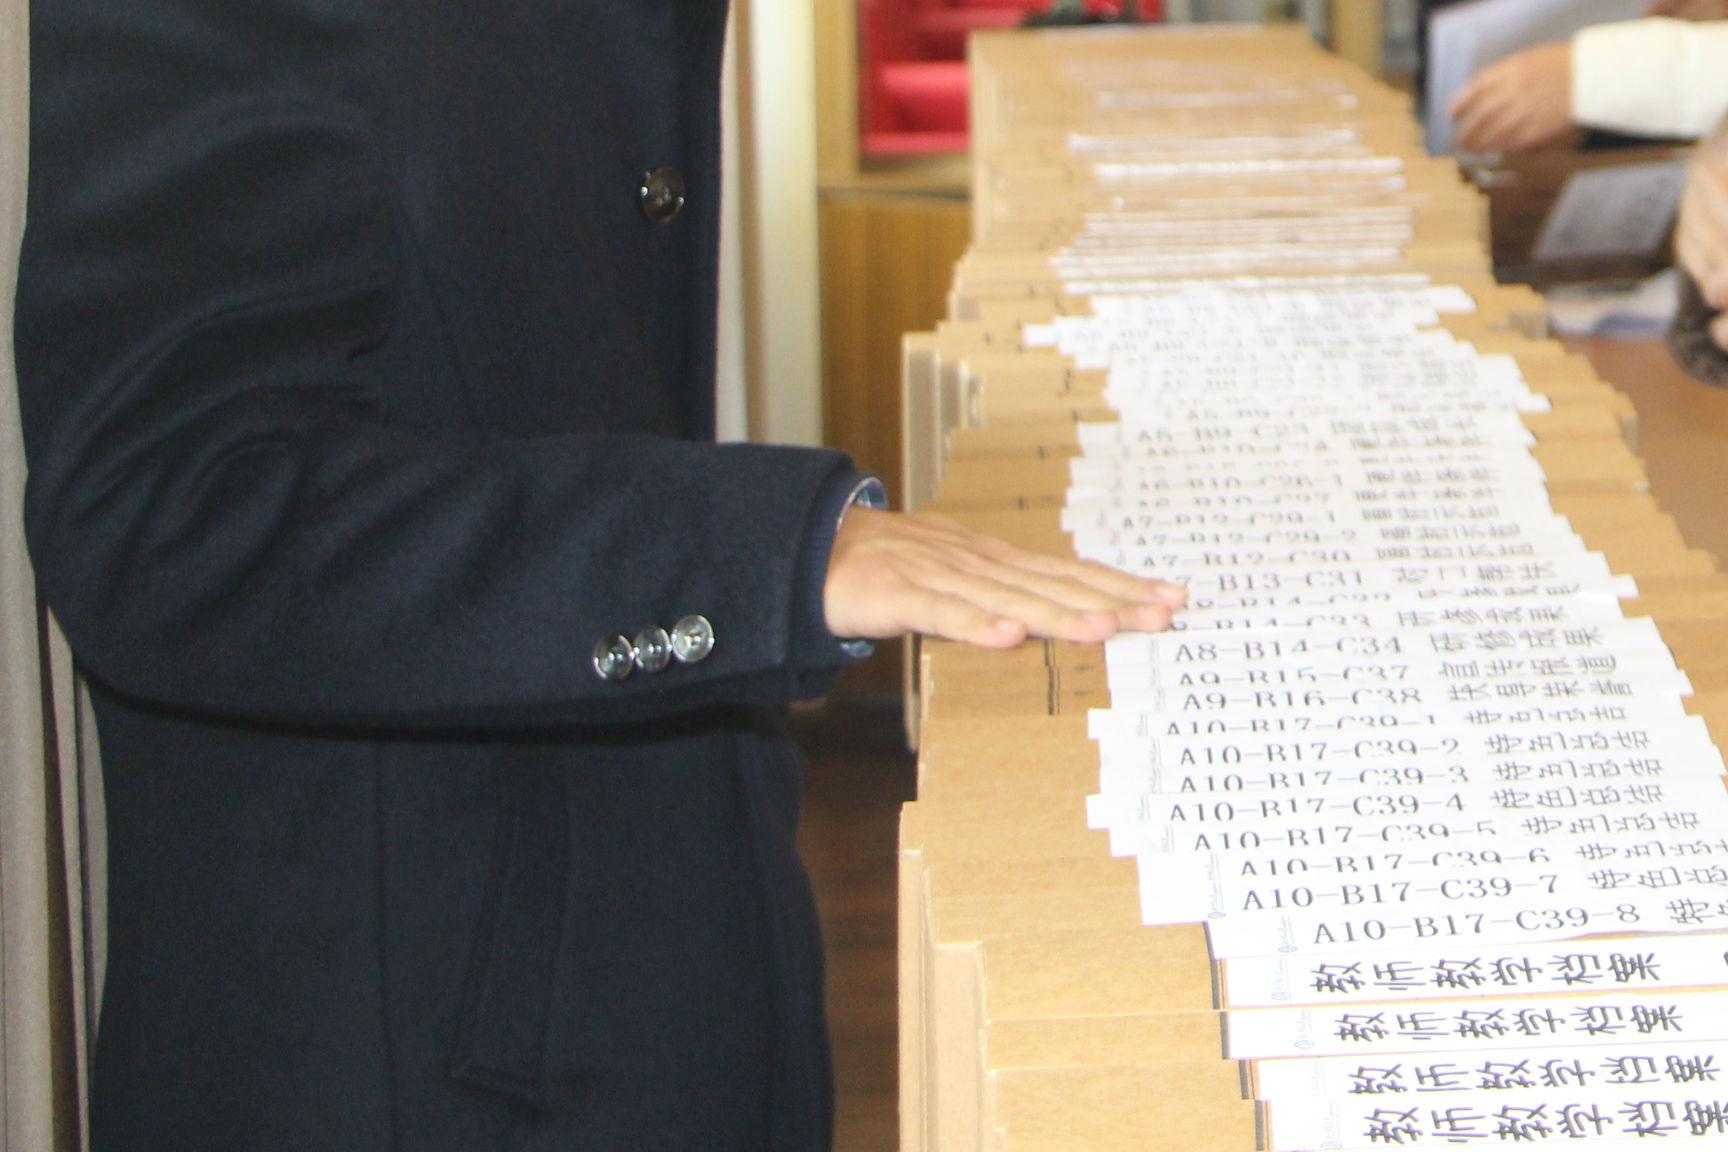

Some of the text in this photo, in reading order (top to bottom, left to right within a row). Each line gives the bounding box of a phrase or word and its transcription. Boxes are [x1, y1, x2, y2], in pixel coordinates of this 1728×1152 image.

[1172, 569, 1362, 591] 7-B13-C31
[1176, 636, 1402, 662] A8-B14-C34
[1180, 665, 1408, 686] A9-B15-C37
[1184, 688, 1422, 710] A9-B16-C38
[1180, 731, 1650, 766] A10-B17-C39-2 特色总结
[1180, 759, 1664, 793] A10-B17-C39-3 特色总结
[1170, 784, 1666, 822] A10-B17-C39-4 特色总结
[1194, 812, 1701, 852] A10-B17-C39-5 特色总结
[1241, 848, 1551, 877] A10-B17-C39-6
[1242, 874, 1558, 910] A10-B17-C39-7
[1314, 904, 1641, 944] A10-B17-C39-8
[1310, 952, 1661, 993] 教师教学档案
[1333, 1004, 1684, 1042] 教师教学档案
[1347, 1054, 1722, 1095] 教师教学档案
